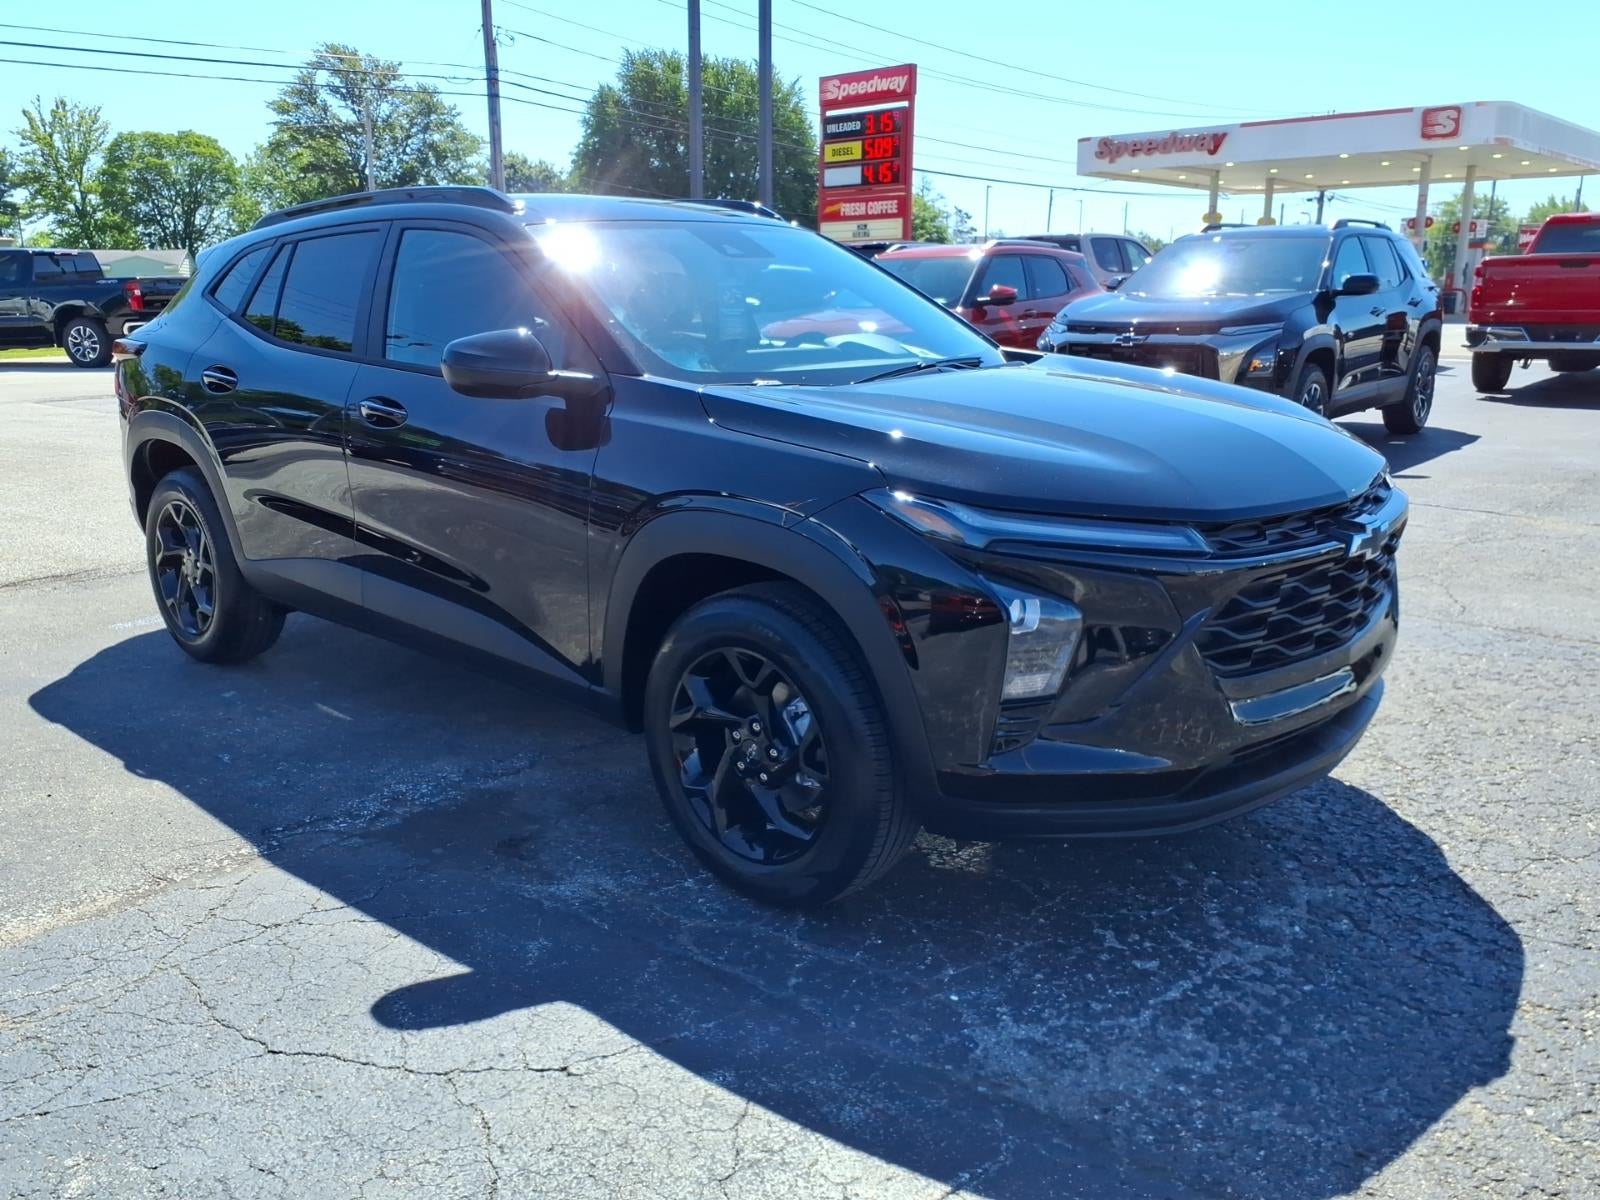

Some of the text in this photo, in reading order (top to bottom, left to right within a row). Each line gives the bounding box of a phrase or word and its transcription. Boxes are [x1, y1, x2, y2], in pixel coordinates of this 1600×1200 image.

[824, 75, 908, 100] Speedway
[826, 120, 861, 133] UNLEADED
[831, 146, 854, 158] DIESEL
[1094, 131, 1229, 164] Speedway
[840, 200, 899, 216] FRESH COFFEE
